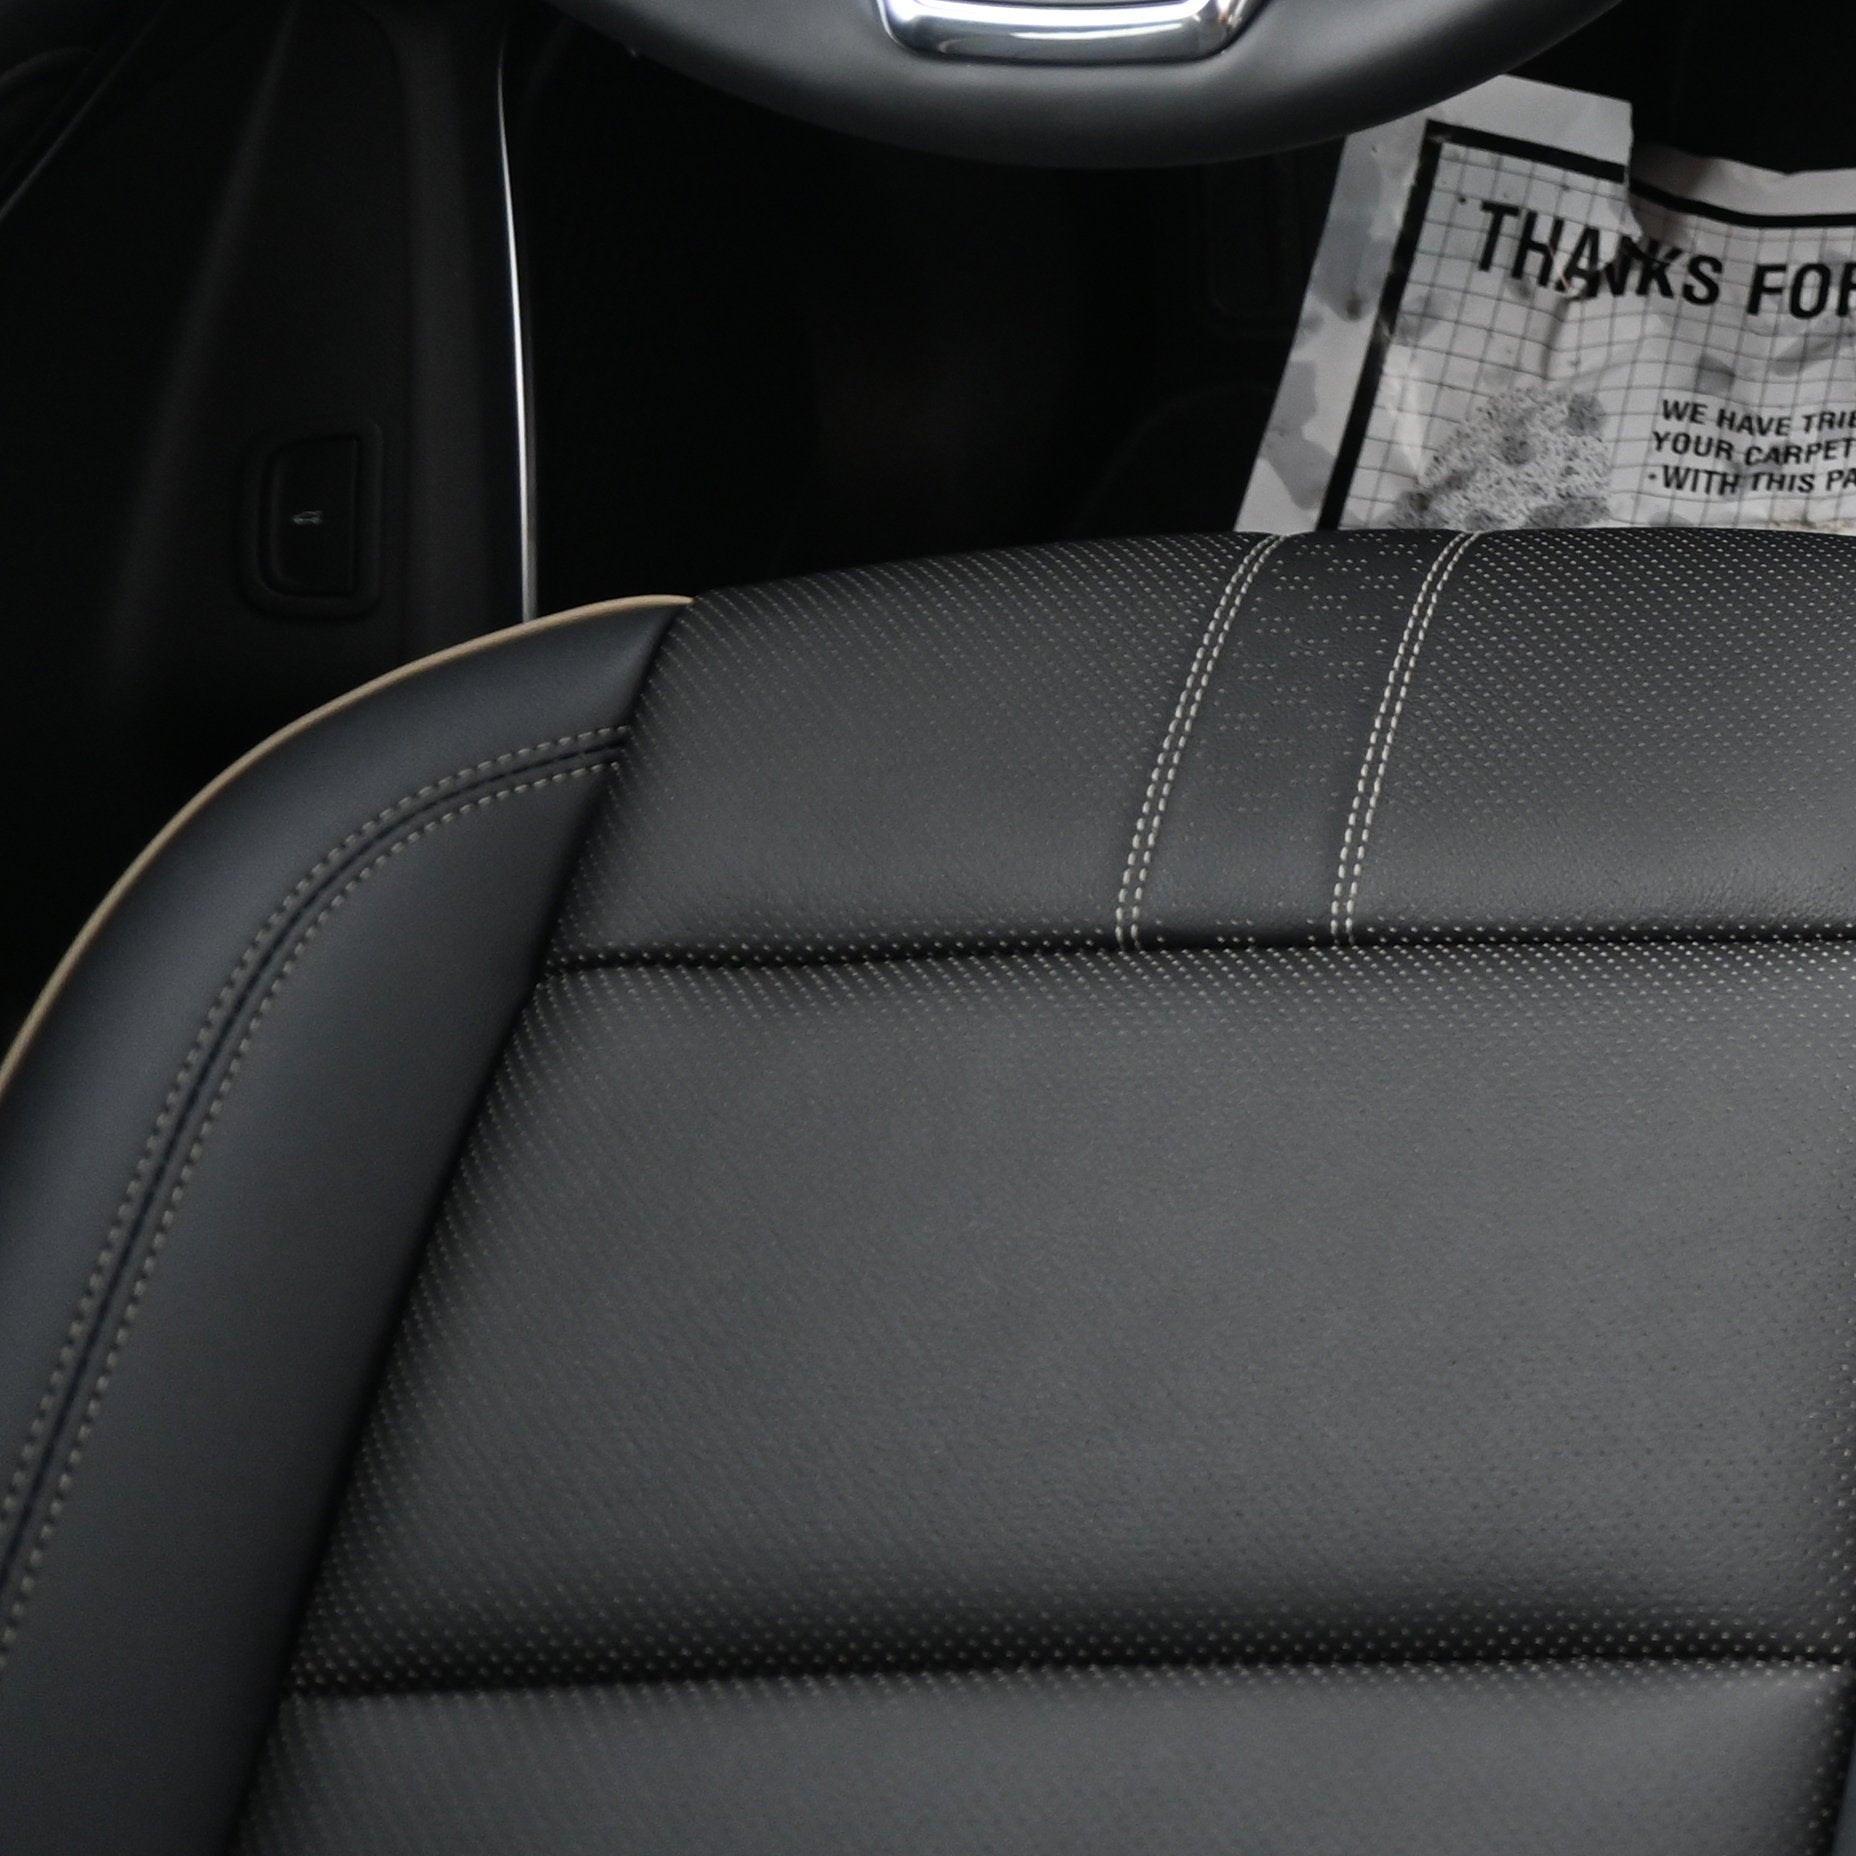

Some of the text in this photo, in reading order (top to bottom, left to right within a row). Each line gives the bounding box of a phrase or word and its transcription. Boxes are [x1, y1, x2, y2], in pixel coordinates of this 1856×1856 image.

[1662, 399, 1708, 425] WE
[1716, 409, 1792, 436] HAVE
[1652, 431, 1734, 462] YOUR
[1662, 465, 1741, 495] WITH
[1751, 472, 1815, 493] THIS
